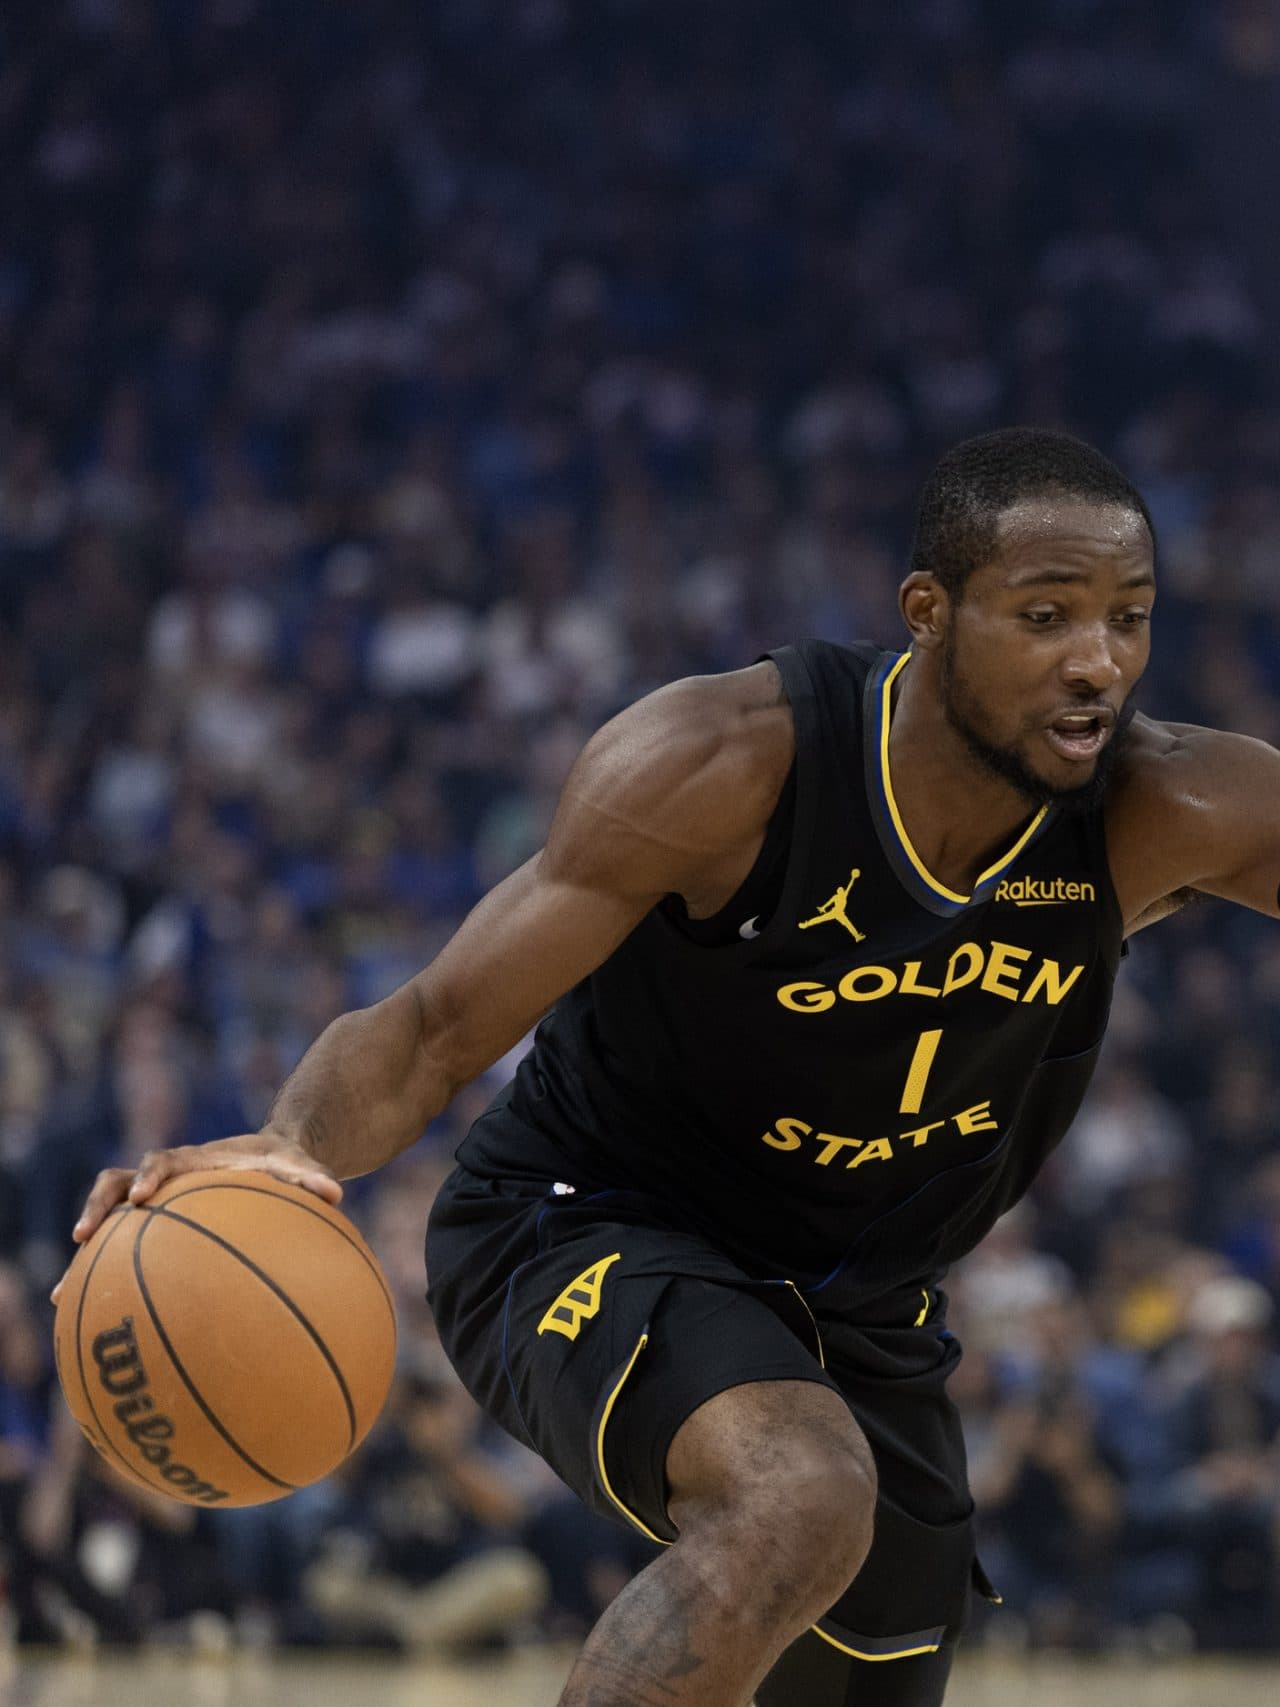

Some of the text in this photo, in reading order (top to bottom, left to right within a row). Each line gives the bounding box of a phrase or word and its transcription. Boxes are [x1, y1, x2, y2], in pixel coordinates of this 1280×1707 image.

[995, 875, 1095, 902] Rakuten
[777, 941, 1084, 1013] GOLDEN
[899, 1028, 943, 1114] 1
[761, 1100, 998, 1169] STATE
[91, 1315, 230, 1503] Wilson
